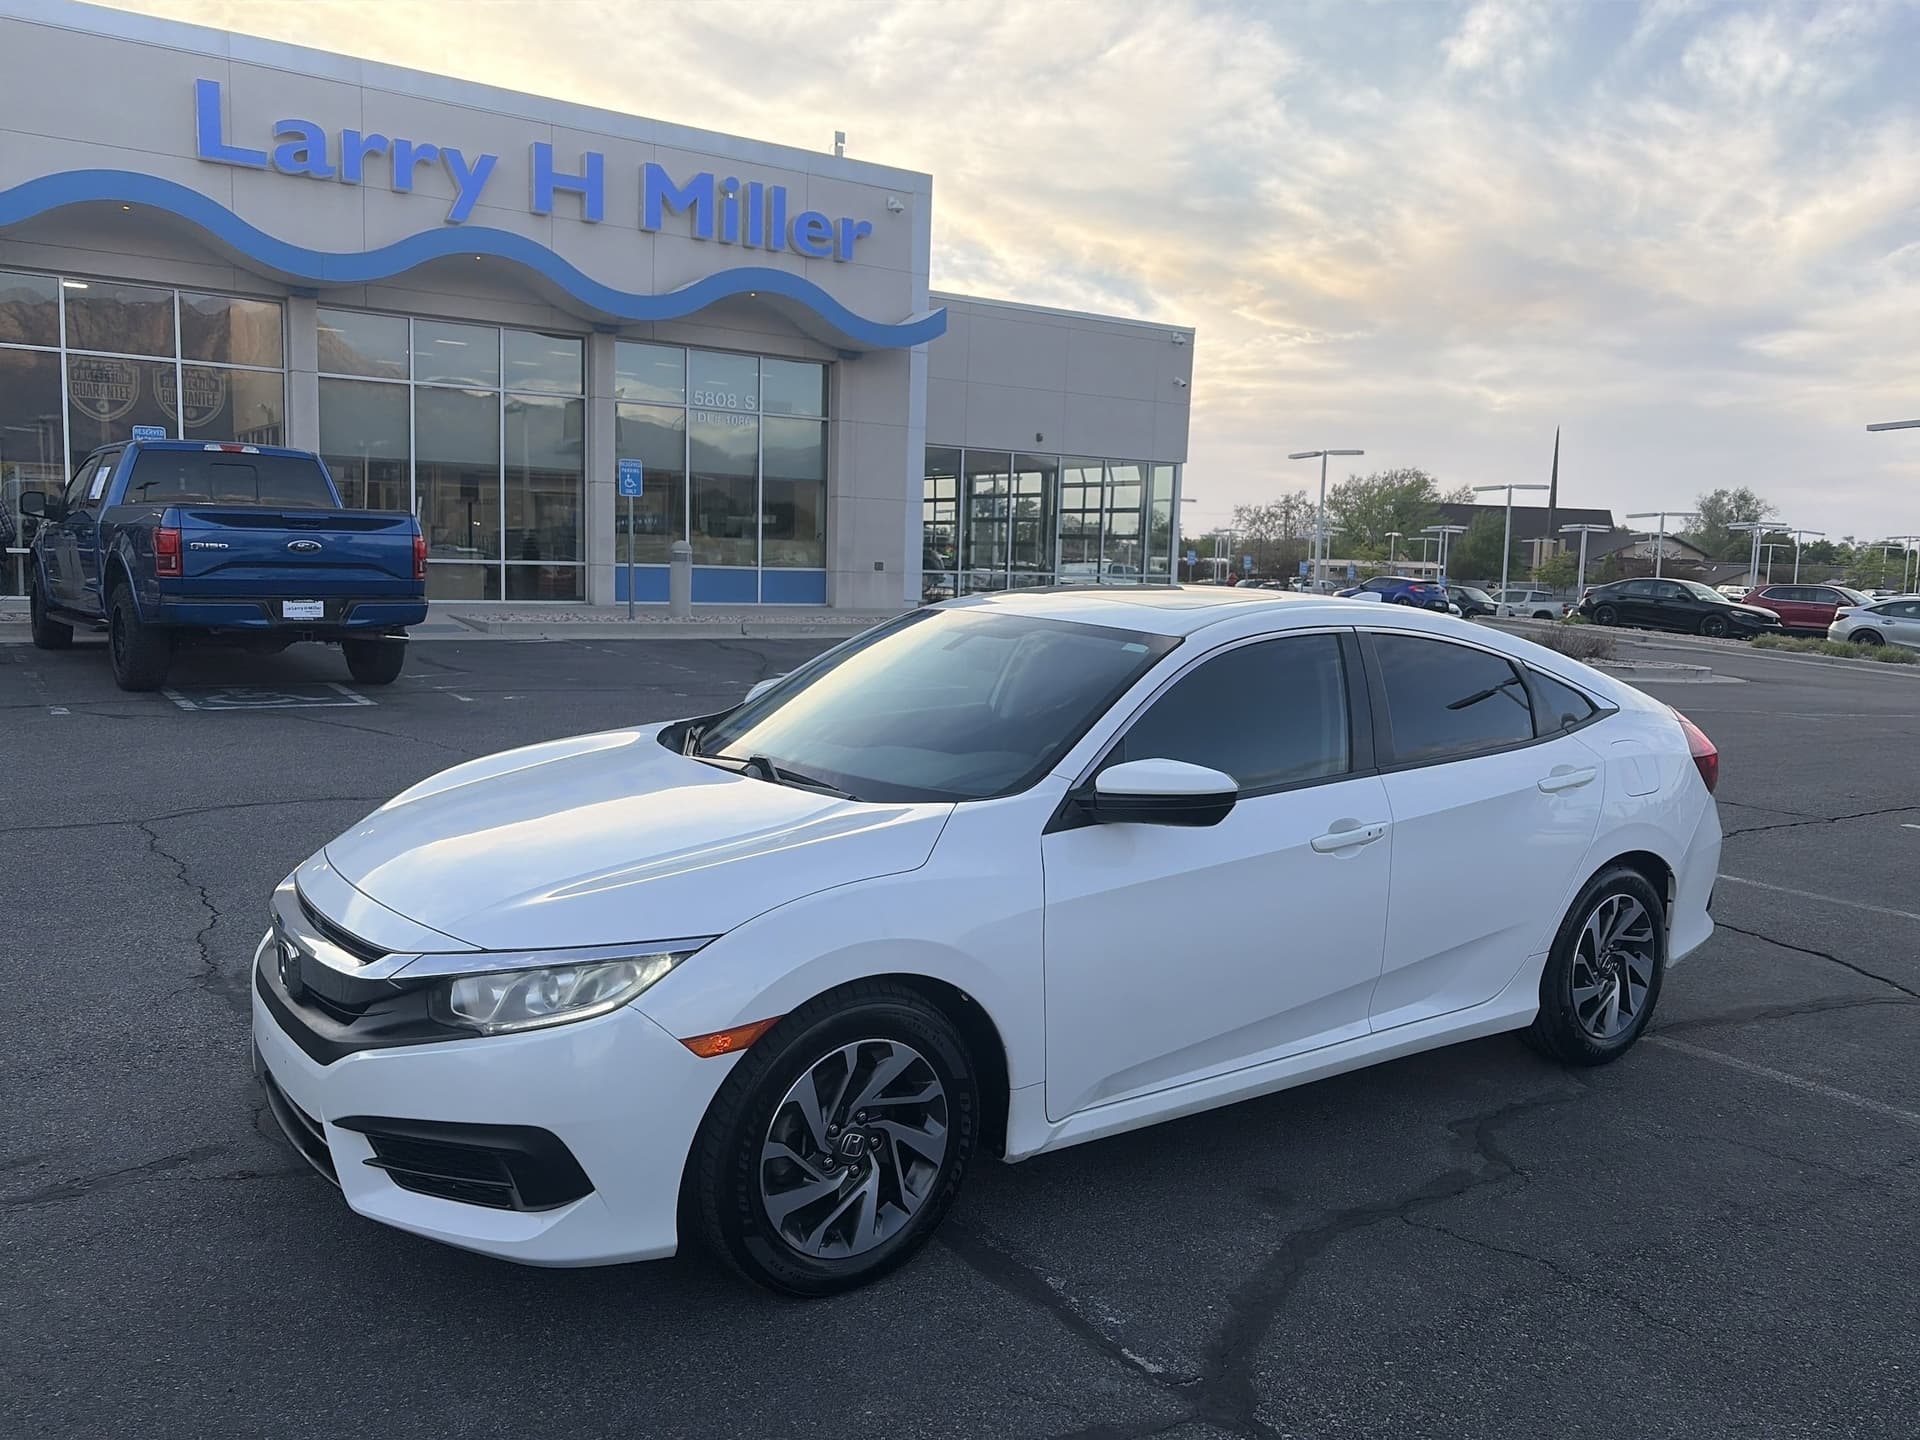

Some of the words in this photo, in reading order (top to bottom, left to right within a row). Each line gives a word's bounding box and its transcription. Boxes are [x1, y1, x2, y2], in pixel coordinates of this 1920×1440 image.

[194, 78, 498, 224] Larry
[530, 141, 605, 224] H
[639, 162, 873, 262] Miller
[73, 383, 131, 399] GUARANTEE
[694, 390, 737, 408] 5808
[744, 395, 755, 410] S
